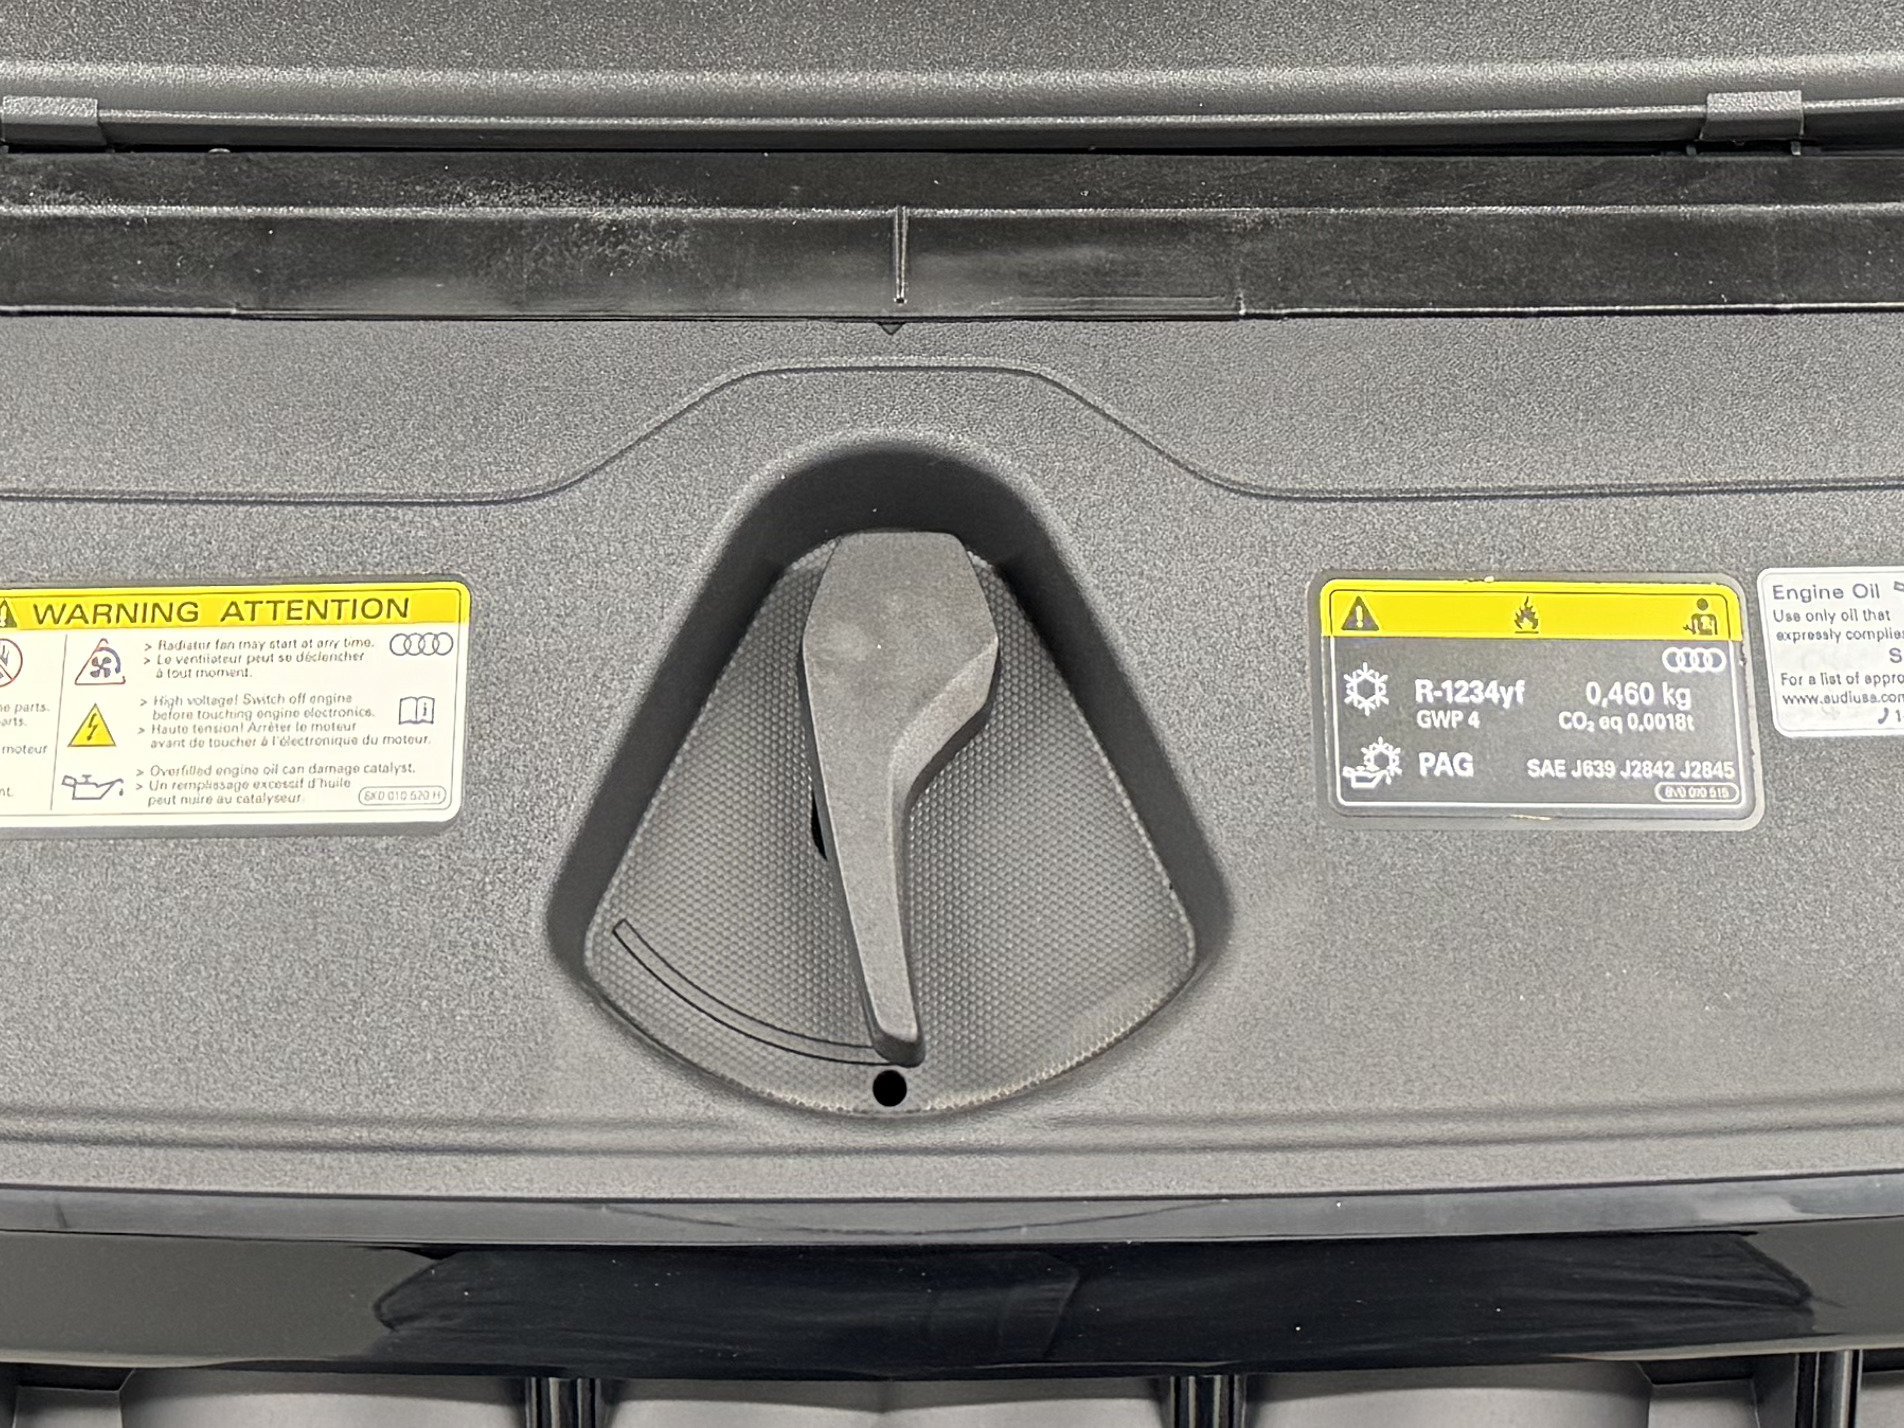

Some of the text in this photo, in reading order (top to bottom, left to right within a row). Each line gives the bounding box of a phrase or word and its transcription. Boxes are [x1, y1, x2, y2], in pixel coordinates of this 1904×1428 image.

[1773, 583, 1880, 603] Engine Oil
[33, 598, 410, 626] WARNING ATTENTION
[1773, 608, 1891, 624] Use only oil that
[1777, 627, 1841, 643] expressly
[158, 638, 375, 652] Radiator fan may start at any time.
[167, 668, 192, 678] tout
[196, 668, 253, 678] moment.
[1781, 673, 1802, 686] For
[1809, 675, 1816, 685] a
[1821, 672, 1841, 685] list
[1846, 671, 1860, 685] of
[153, 692, 353, 709] High voltage! Switch off engine
[1414, 679, 1525, 708] R-1234yf
[1585, 681, 1691, 710] 0,460 kg
[14, 702, 50, 716] parts.
[152, 706, 375, 722] before touching engine electronics.
[1416, 710, 1480, 729] GWP 4
[1598, 714, 1623, 735] eq
[150, 738, 185, 749] avant
[189, 737, 205, 748] de
[209, 736, 256, 748] toucher
[362, 734, 379, 746] du
[382, 734, 432, 745] moteur.
[149, 761, 416, 778] Overfilled engine oil can damage catalyst.
[1418, 752, 1474, 777] PAG
[1527, 759, 1735, 779] SAE J639 J2842 J2845
[149, 778, 168, 791] Un
[171, 777, 250, 792] remplissage
[253, 777, 304, 790] excessif
[147, 792, 302, 807] peut nuire au catalyseur.
